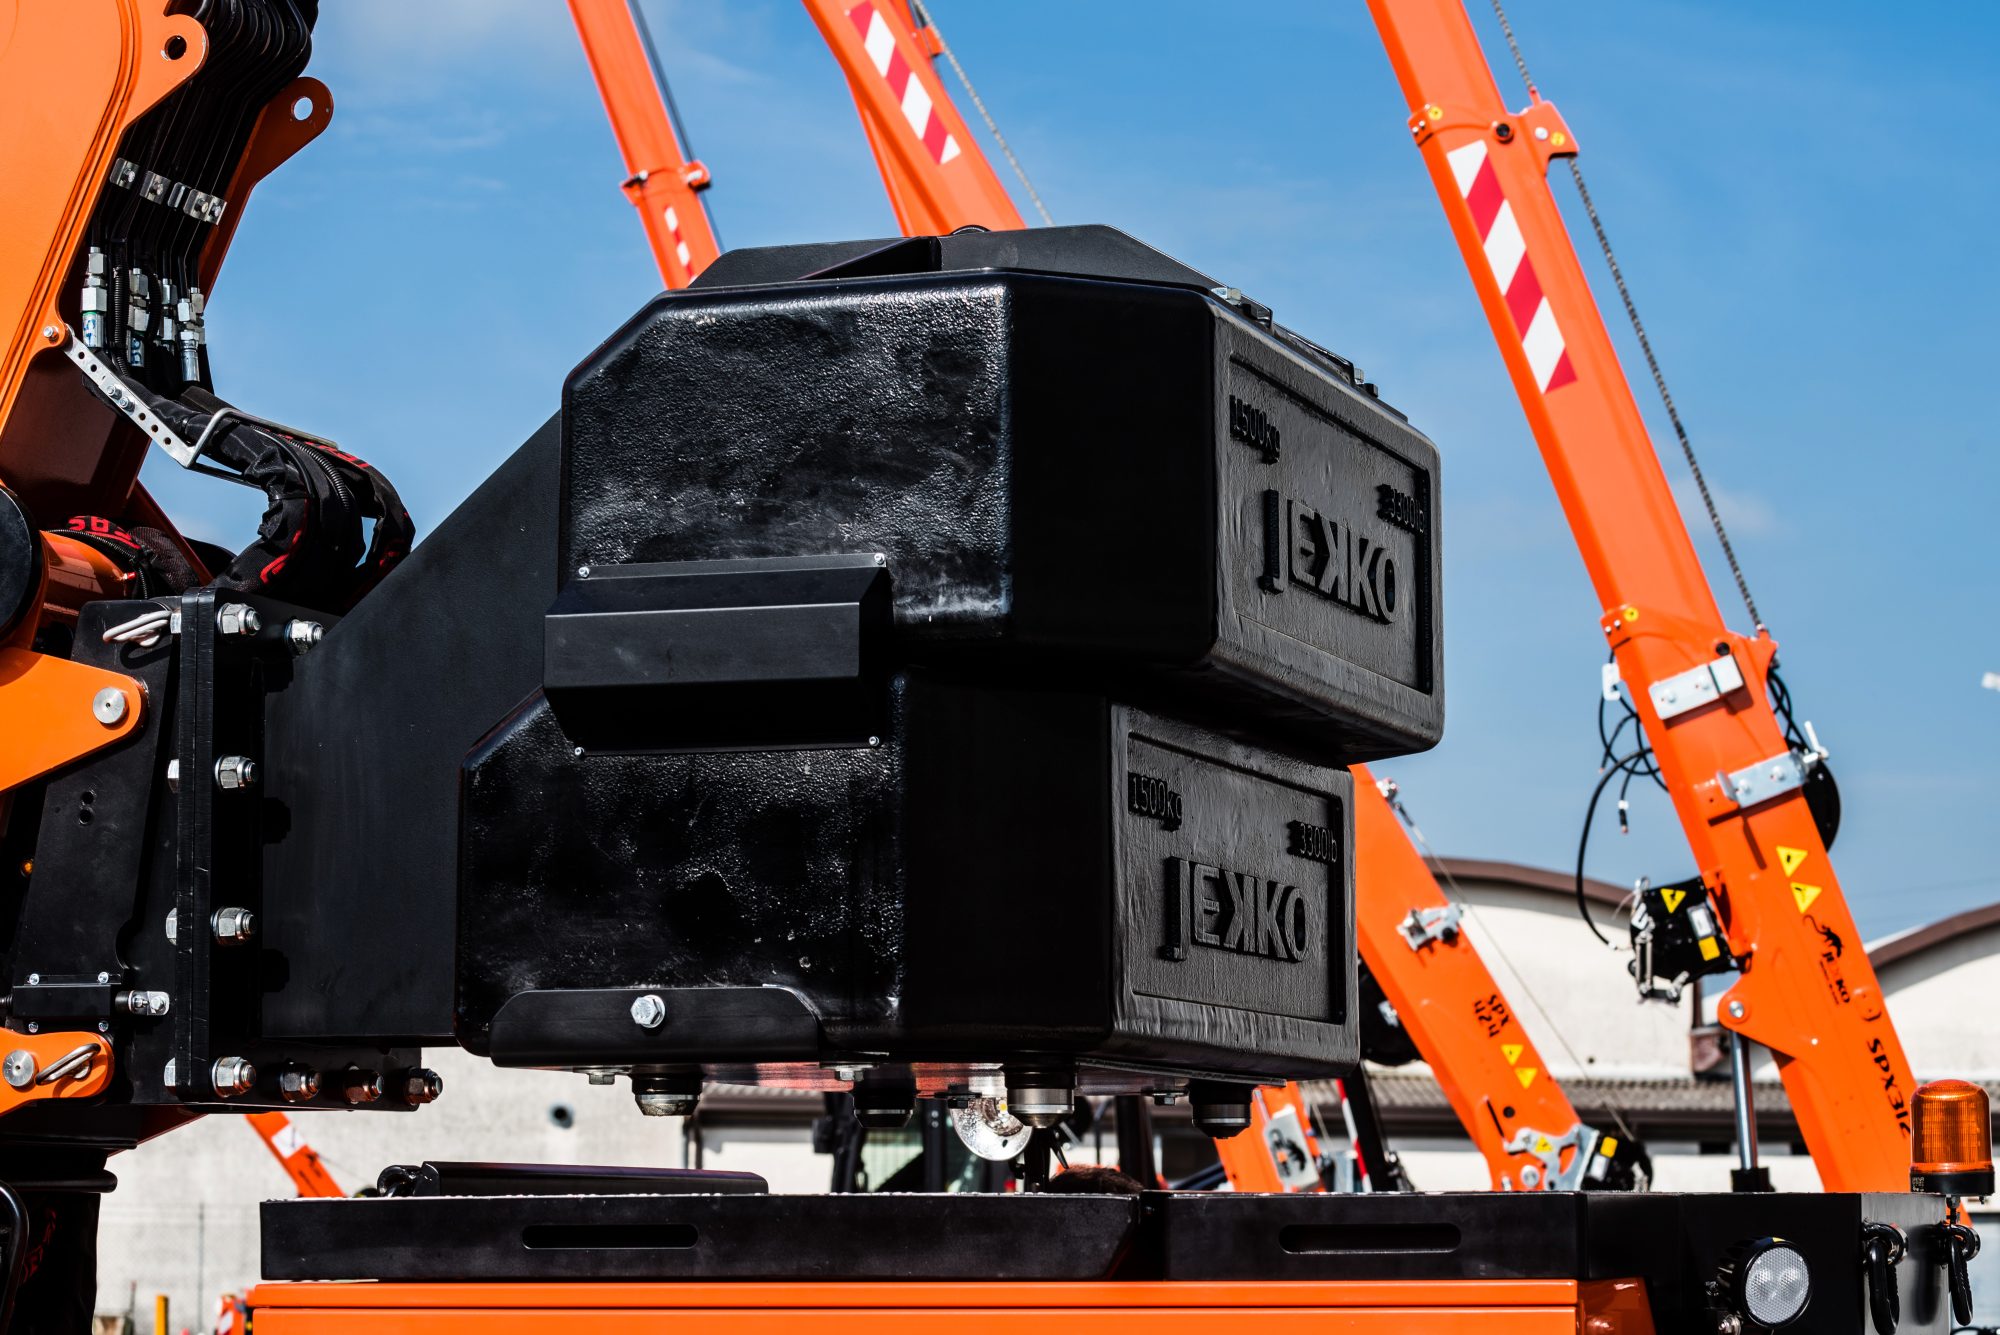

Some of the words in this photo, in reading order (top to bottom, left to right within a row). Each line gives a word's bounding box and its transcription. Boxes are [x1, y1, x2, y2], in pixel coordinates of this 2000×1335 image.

[1259, 489, 1397, 625] JEKKO
[1128, 772, 1182, 832] 1500kg
[1287, 820, 1337, 864] 3300lb
[1158, 856, 1309, 964] JEKKO
[1822, 952, 1850, 1003] JEKO
